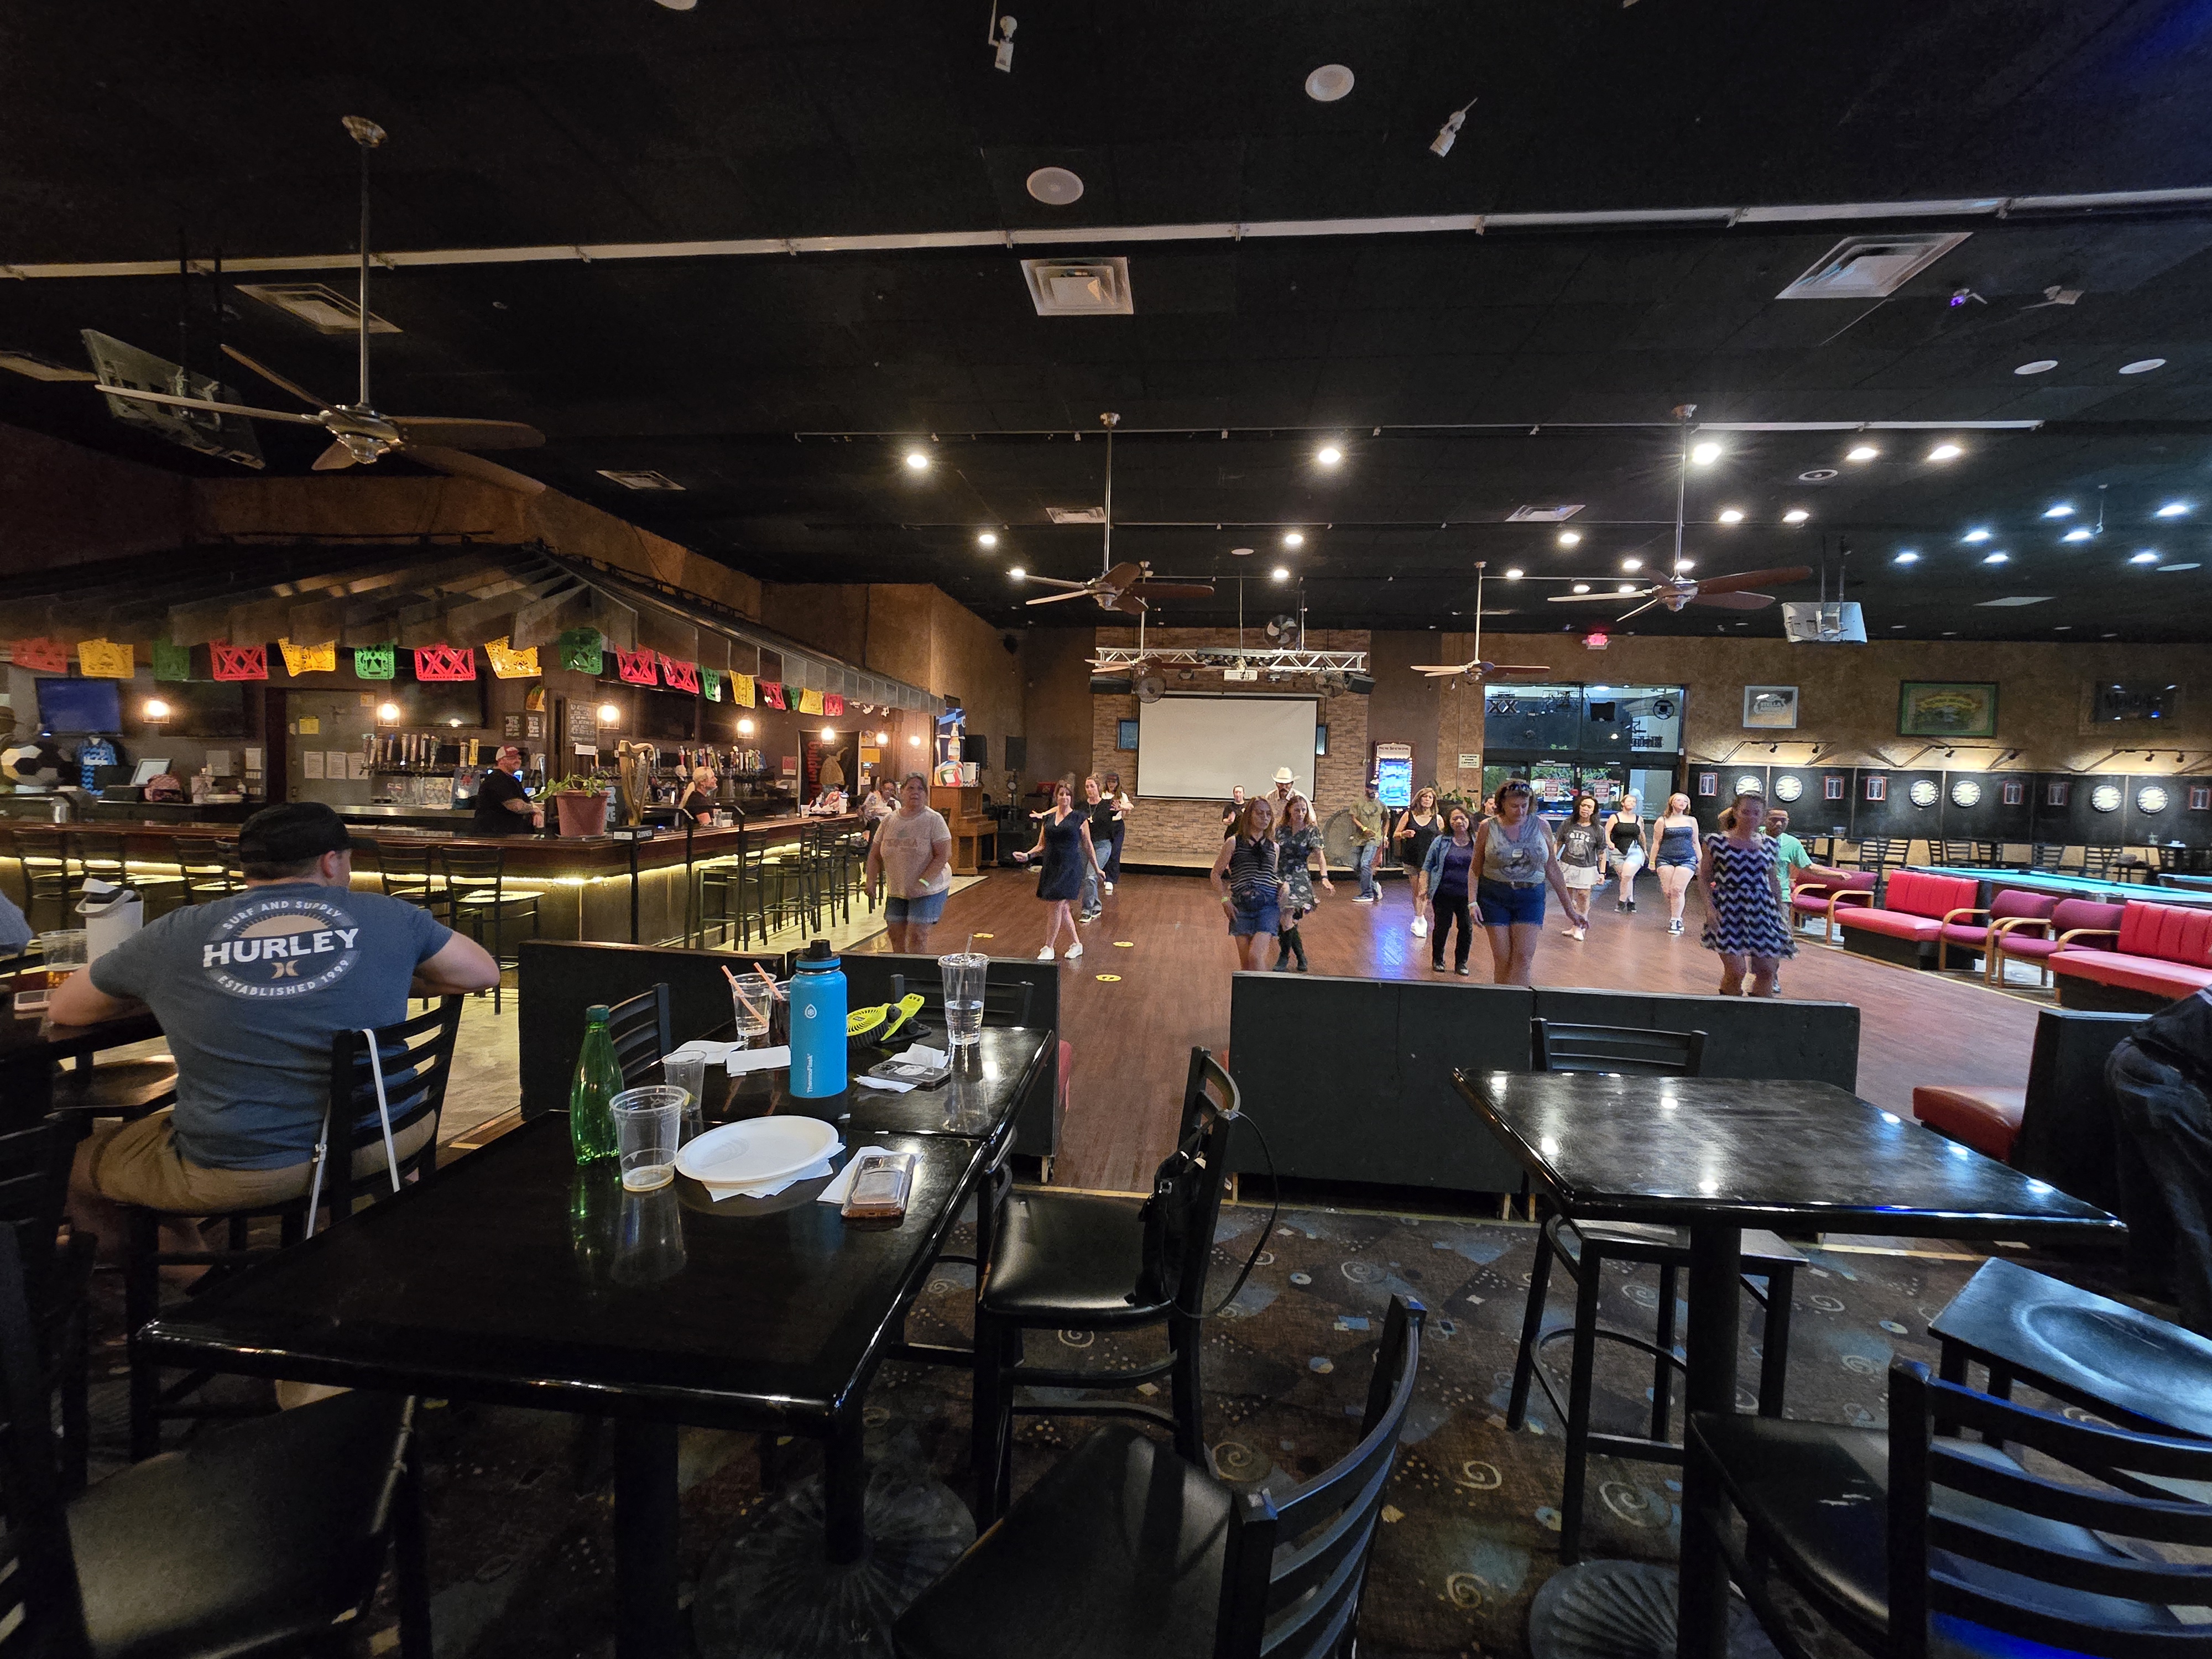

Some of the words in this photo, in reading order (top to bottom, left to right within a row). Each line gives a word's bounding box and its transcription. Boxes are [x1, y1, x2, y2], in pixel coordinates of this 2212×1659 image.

[223, 908, 255, 930] SURF
[261, 900, 289, 912] AND
[295, 901, 342, 918] SUPPLY
[203, 928, 359, 968] HURLEY
[217, 975, 316, 997] ESTABLISHED
[320, 959, 349, 983] 1999
